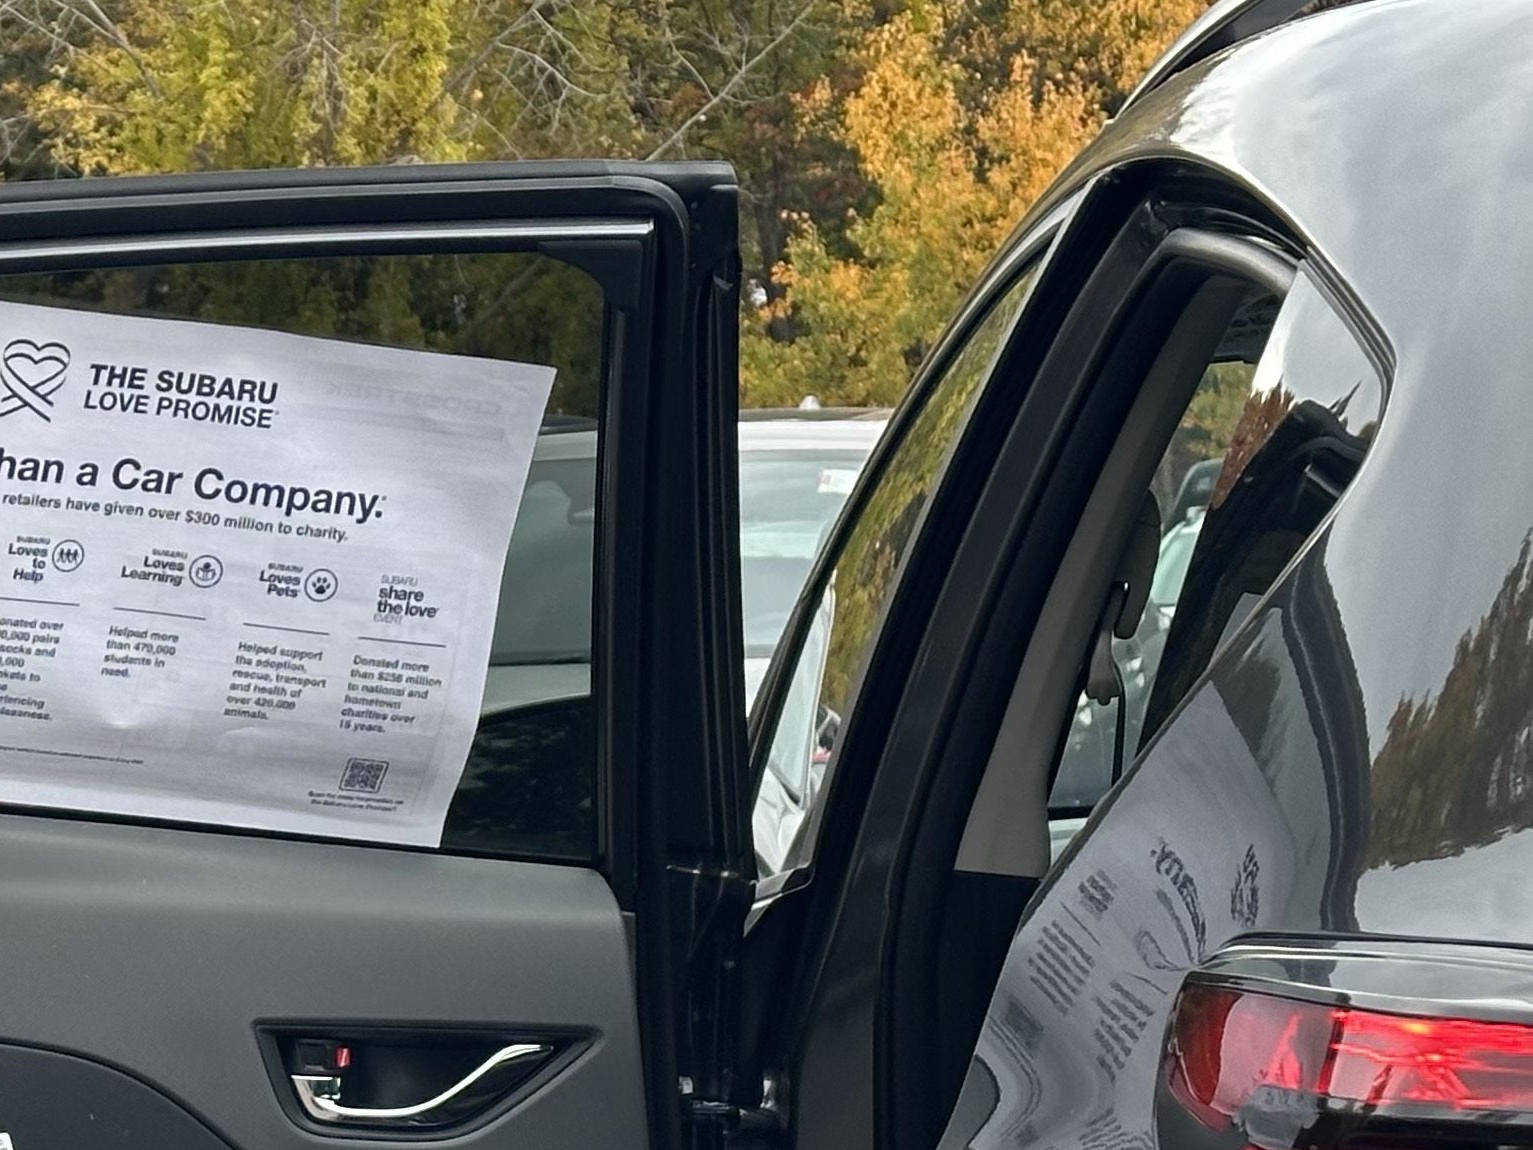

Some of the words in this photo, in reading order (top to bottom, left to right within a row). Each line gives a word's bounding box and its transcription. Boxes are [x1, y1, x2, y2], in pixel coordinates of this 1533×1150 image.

[88, 364, 148, 390] THE
[154, 370, 279, 405] SUBARU
[83, 391, 149, 415] LOVE
[75, 461, 98, 487] a
[112, 458, 183, 495] Car
[194, 468, 385, 524] Company.
[2, 489, 61, 511] retailers
[65, 497, 98, 512] have
[104, 500, 144, 519] given
[148, 507, 181, 521] over
[185, 507, 220, 527] $300
[223, 513, 273, 534] million
[277, 520, 291, 535] to
[295, 523, 348, 544] charity.
[8, 543, 48, 557] Loves
[32, 557, 45, 569] to
[144, 556, 185, 571] Loves
[13, 568, 43, 583] Help
[121, 565, 183, 587] Learning
[259, 570, 300, 585] Loves
[381, 574, 418, 587] SUBARU
[267, 584, 298, 598] Pets
[379, 586, 424, 602] share
[377, 600, 403, 614] the
[405, 602, 437, 618] love
[40, 621, 63, 630] over
[373, 614, 403, 625] EVENT
[32, 633, 60, 644] pairs
[109, 625, 147, 640] Helped
[150, 632, 179, 643] more
[0, 644, 31, 655] socks
[35, 647, 56, 658] and
[106, 640, 130, 650] than
[238, 641, 277, 656] Helped
[280, 648, 323, 661] support
[104, 654, 151, 666] students
[154, 658, 165, 667] in
[235, 655, 252, 666] the
[255, 658, 307, 673] adoption,
[353, 655, 399, 669] Donated
[401, 662, 429, 672] more
[30, 672, 41, 682] to
[101, 667, 130, 677] need.
[232, 669, 273, 683] rescue,
[276, 674, 327, 688] transport
[350, 669, 374, 679] than
[405, 676, 442, 686] million
[229, 682, 251, 691] and
[253, 684, 287, 697] health
[290, 689, 302, 698] of
[348, 682, 359, 691] to
[361, 684, 404, 696] national
[407, 689, 428, 699] and
[226, 696, 252, 705] over
[344, 694, 401, 709] hometown
[223, 708, 269, 720] animals.
[341, 708, 388, 721] charities
[390, 714, 415, 724] over
[353, 722, 386, 733] years.
